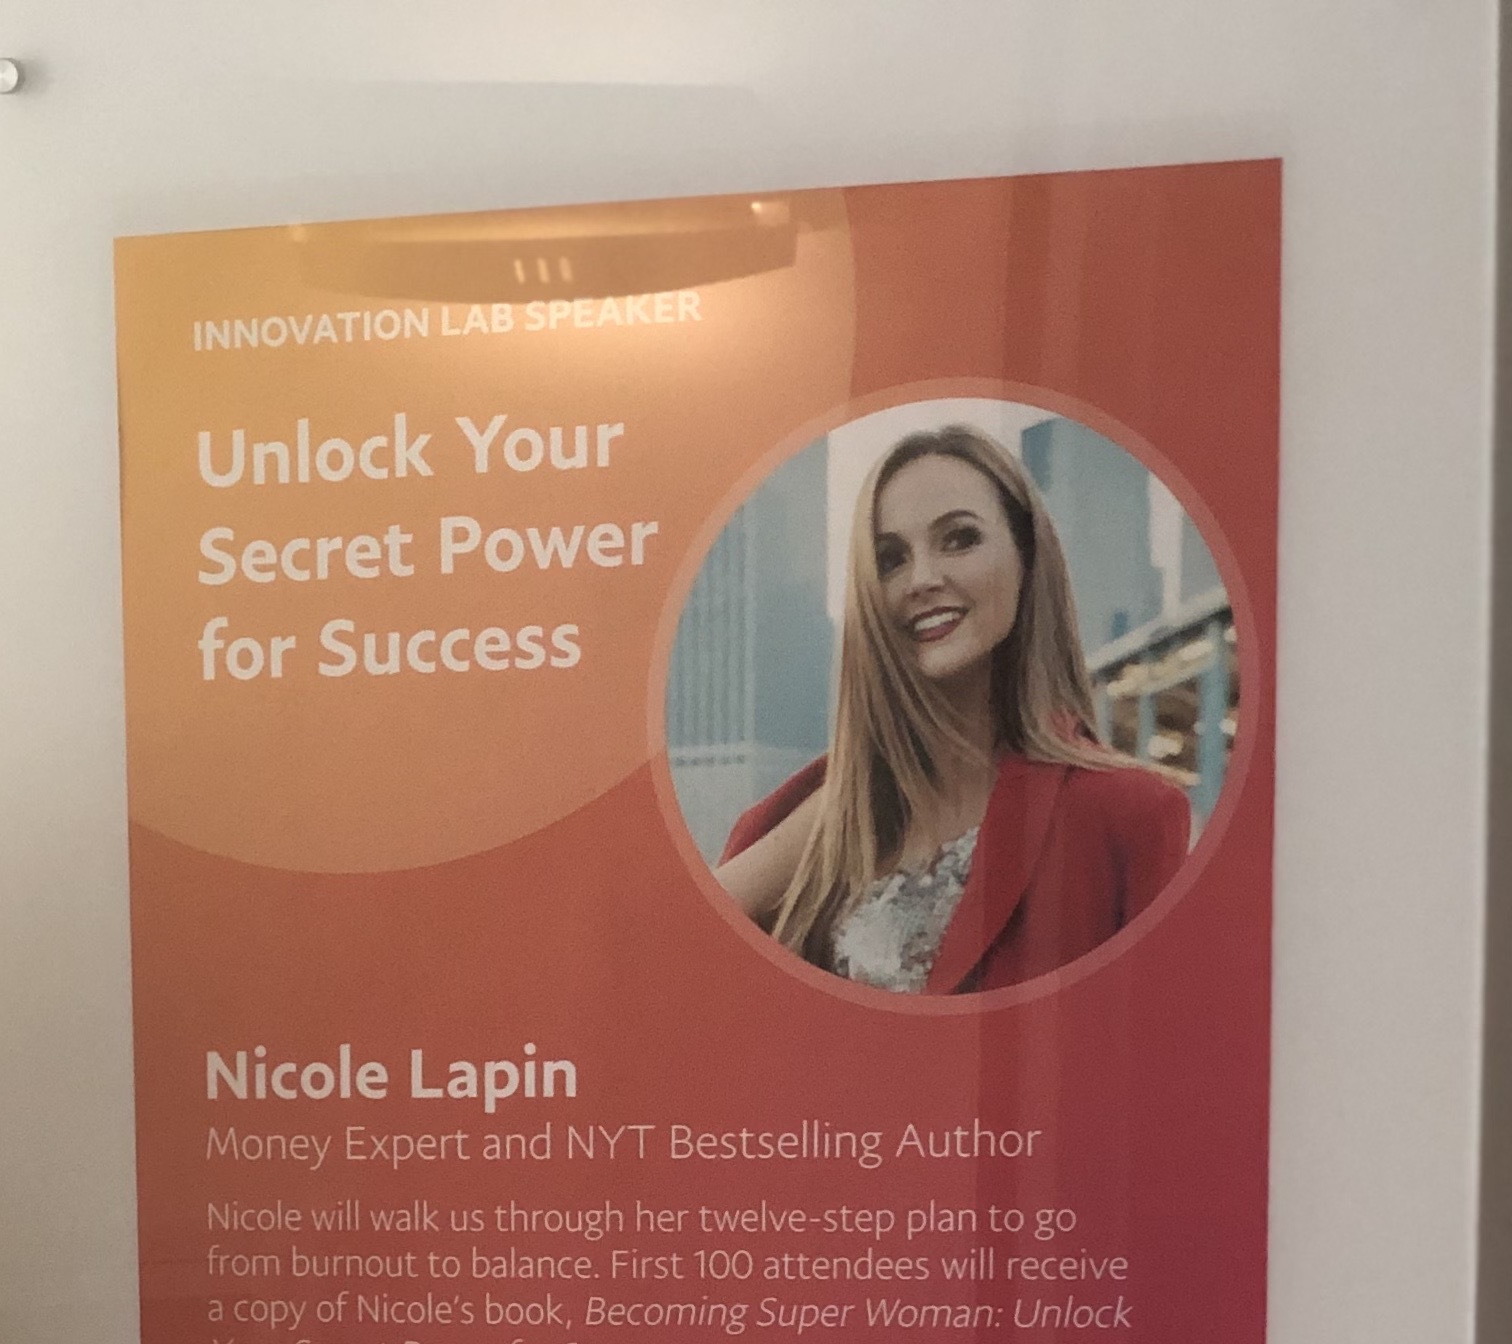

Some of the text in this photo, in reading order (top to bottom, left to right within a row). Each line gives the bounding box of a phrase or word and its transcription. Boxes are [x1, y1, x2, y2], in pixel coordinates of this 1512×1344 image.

[194, 290, 703, 351] INNOVATION LAB SPEAKER
[198, 413, 624, 487] Unlock Your
[199, 514, 660, 585] Secret Power
[198, 617, 581, 680] for Success
[207, 1043, 576, 1113] Nicole Lapin
[207, 1118, 1042, 1170] Money Expert and NYT Bestselling Author
[208, 1199, 1076, 1241] Nicole will walk us through her twelve-step plan to go
[208, 1244, 1129, 1281] from burnout to balance. First 100 attendees will receive
[208, 1291, 1132, 1335] a copy of Nicole's book, Becoming Super Woman: Unlock
